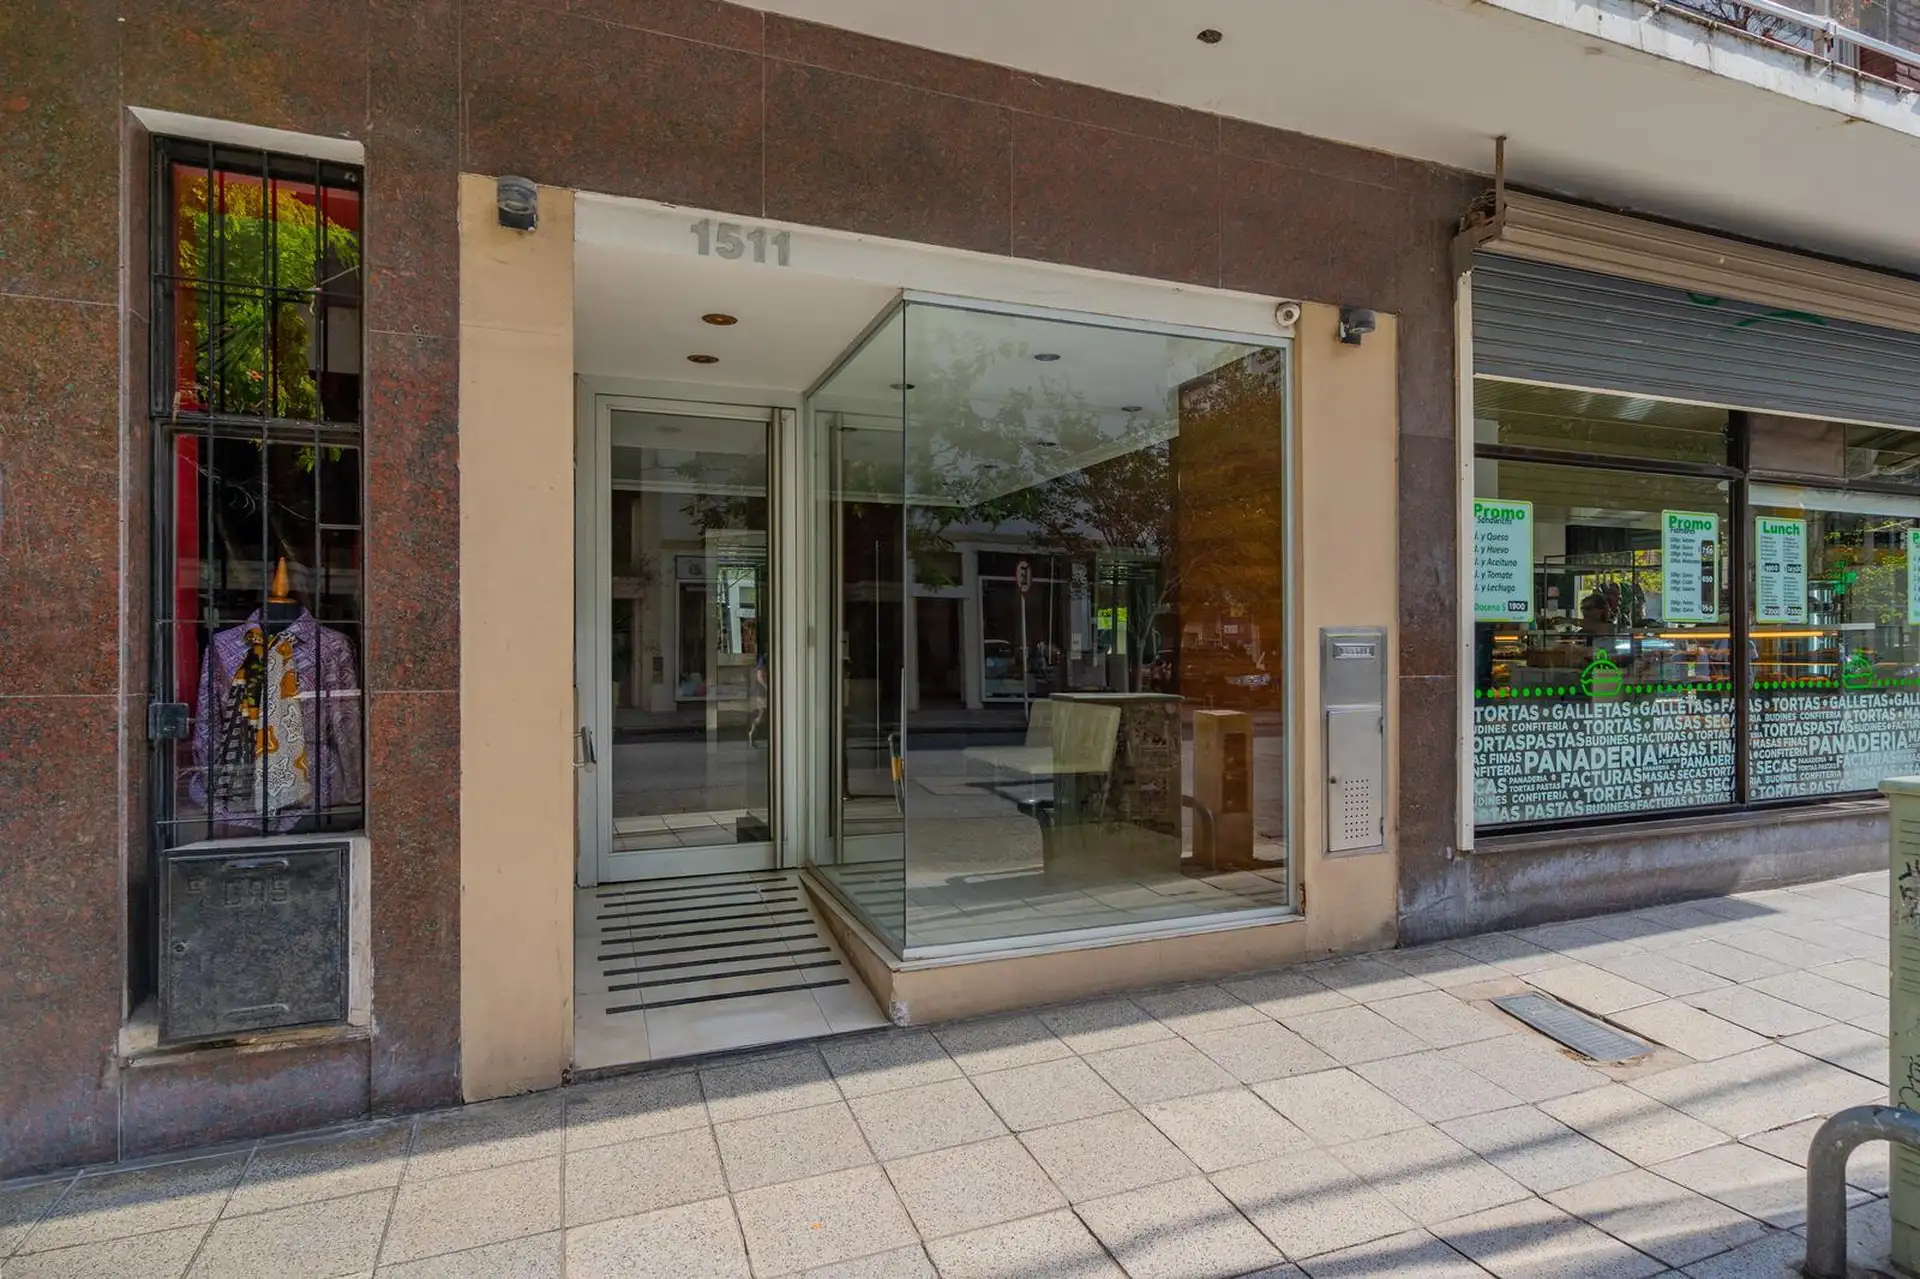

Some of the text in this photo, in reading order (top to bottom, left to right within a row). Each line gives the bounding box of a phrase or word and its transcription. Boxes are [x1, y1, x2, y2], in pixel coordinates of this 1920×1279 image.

[690, 217, 791, 266] 1511
[1474, 503, 1525, 520] Promo
[1669, 515, 1712, 531] Promo
[1763, 521, 1800, 535] Lunch
[1481, 533, 1487, 542] y
[1487, 531, 1509, 541] Queso
[1481, 546, 1487, 555] y
[1481, 559, 1487, 568] y
[1481, 572, 1487, 581] y
[1481, 585, 1487, 594] y
[1771, 696, 1820, 712] TORTAS
[1830, 694, 1888, 709] GALLETAS
[1474, 705, 1539, 723] TORTAS
[1552, 702, 1630, 719] GALLETAS
[1640, 699, 1713, 716] GALLETAS
[1765, 712, 1797, 722] BUDINES
[1800, 711, 1841, 720] CONFITERIA
[1853, 708, 1895, 723] TORTAS
[1511, 722, 1568, 733] CONFITERIA
[1584, 717, 1642, 735] TORTAS
[1653, 716, 1701, 732] MASAS
[1854, 722, 1887, 732] BUDINES
[1585, 735, 1629, 747] BUDINES
[1637, 732, 1687, 743] FACTURAS
[1696, 729, 1730, 740] TORTAS
[1753, 737, 1808, 749] MASAS FINAS
[1809, 731, 1909, 755] PANADERIA
[1658, 741, 1706, 757] MASAS
[1759, 748, 1808, 759] CONFITERIA
[1490, 752, 1522, 764] FINAS
[1524, 744, 1658, 774] PANADERIA
[1756, 758, 1797, 774] SECAS
[1509, 775, 1548, 784] PANADERIA
[1561, 768, 1642, 789] FACTURAS
[1642, 769, 1675, 782] MASAS
[1677, 767, 1707, 779] SECAS
[1765, 774, 1797, 783] BUDINES
[1800, 771, 1842, 781] CONFITERIA
[1509, 782, 1561, 793] TORTAS PASTAS
[1512, 792, 1569, 804] CONFITERIA
[1584, 785, 1642, 803] TORTAS
[1654, 780, 1701, 797] MASAS
[1758, 779, 1854, 799] TORTAS PASTAS
[1525, 800, 1584, 821] PASTAS
[1585, 801, 1629, 815] BUDINES
[1637, 797, 1687, 810] FACTURAS
[1696, 793, 1730, 804] TORTAS
